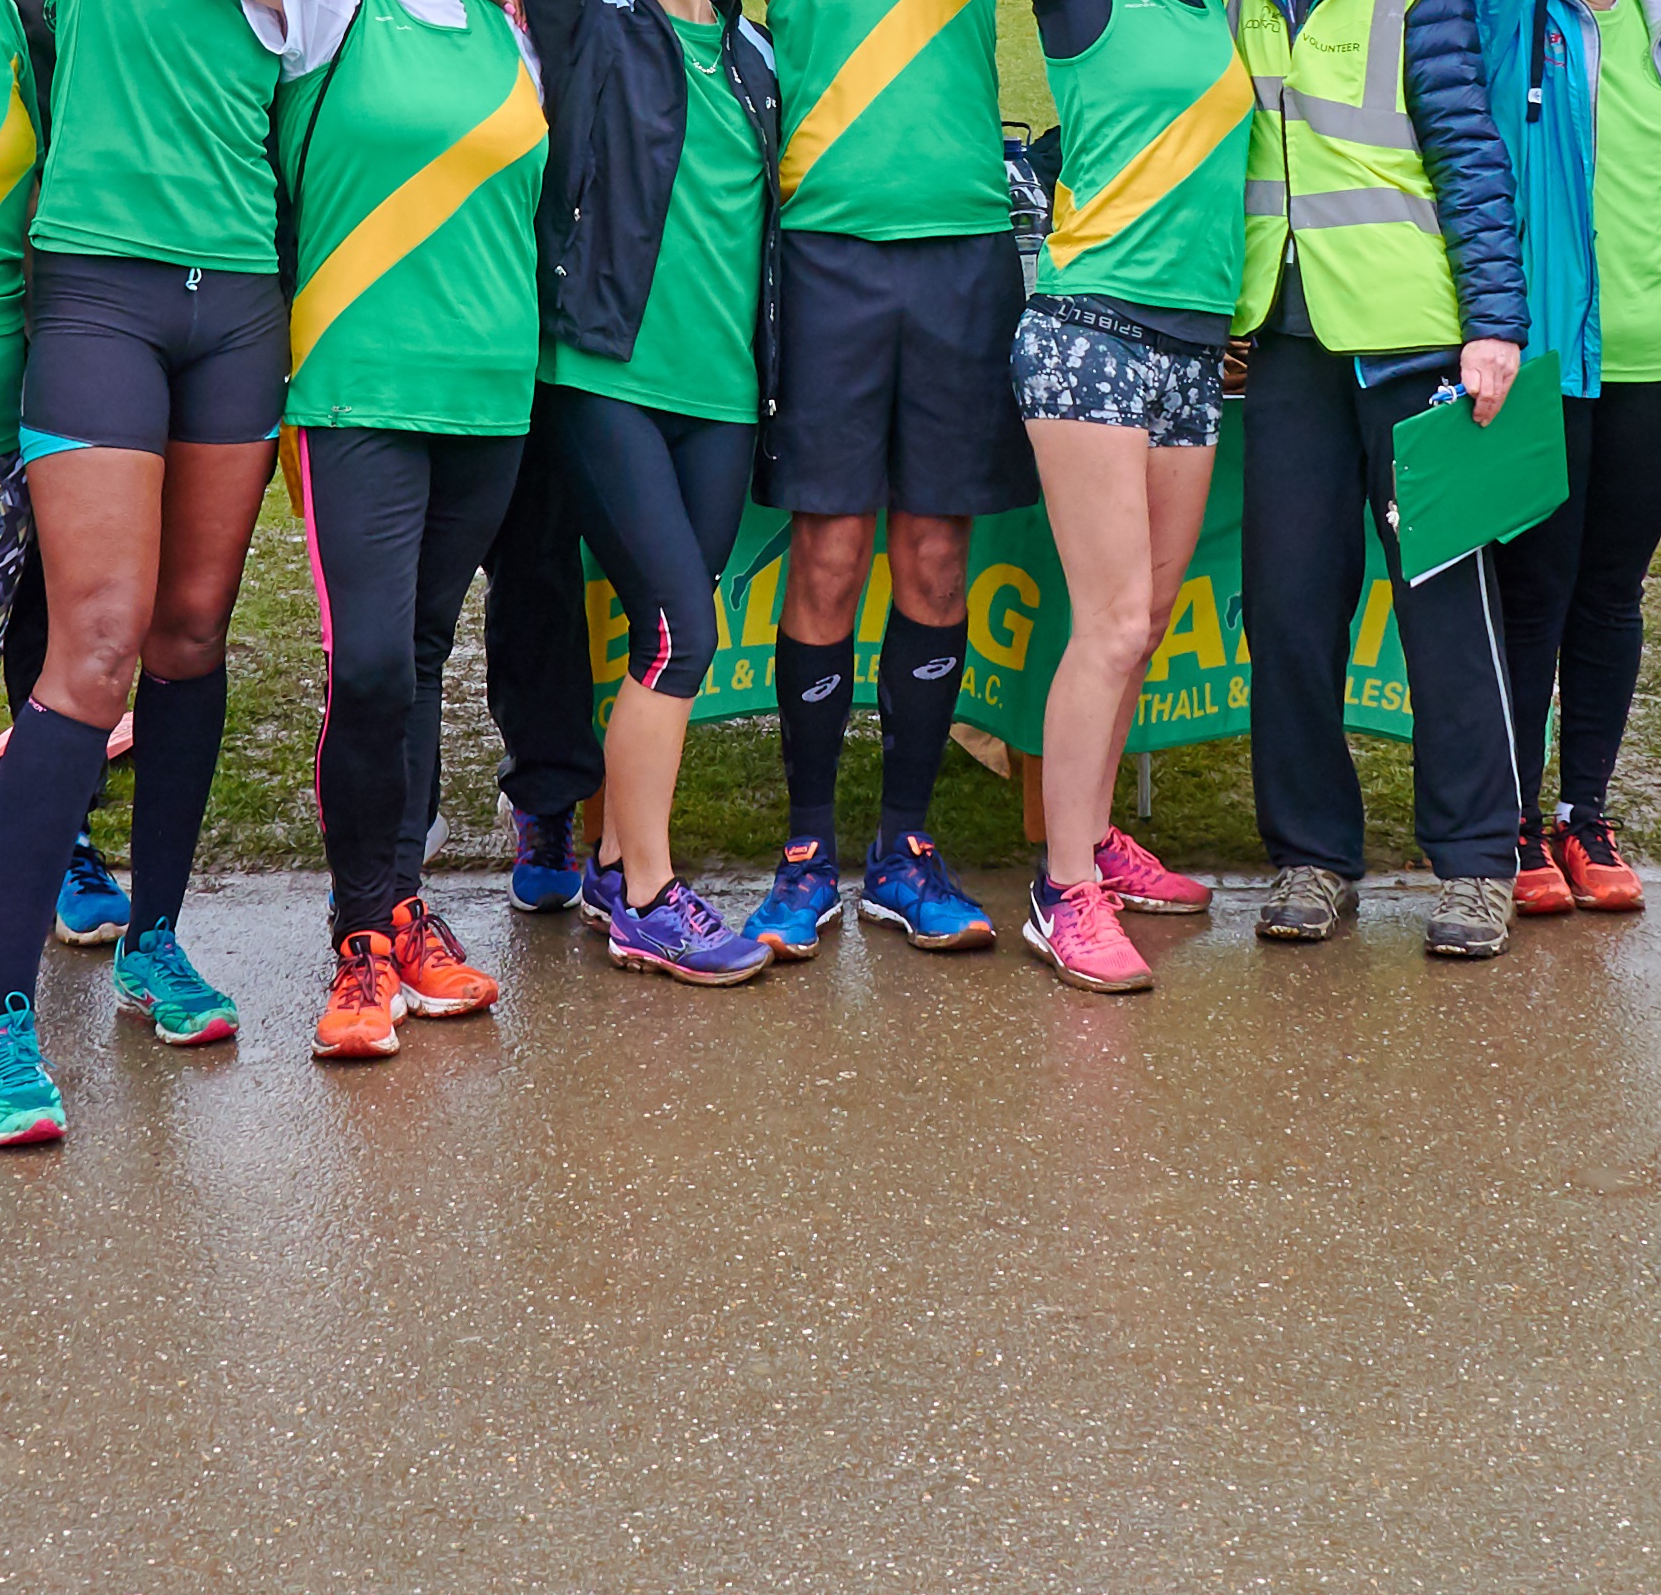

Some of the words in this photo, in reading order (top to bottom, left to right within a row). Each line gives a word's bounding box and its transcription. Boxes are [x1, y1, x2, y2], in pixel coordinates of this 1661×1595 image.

[1302, 32, 1361, 53] VOLUNTEER
[1057, 304, 1144, 339] SPIBELT
[959, 666, 1004, 709] A.C.
[1137, 682, 1219, 726] THALL
